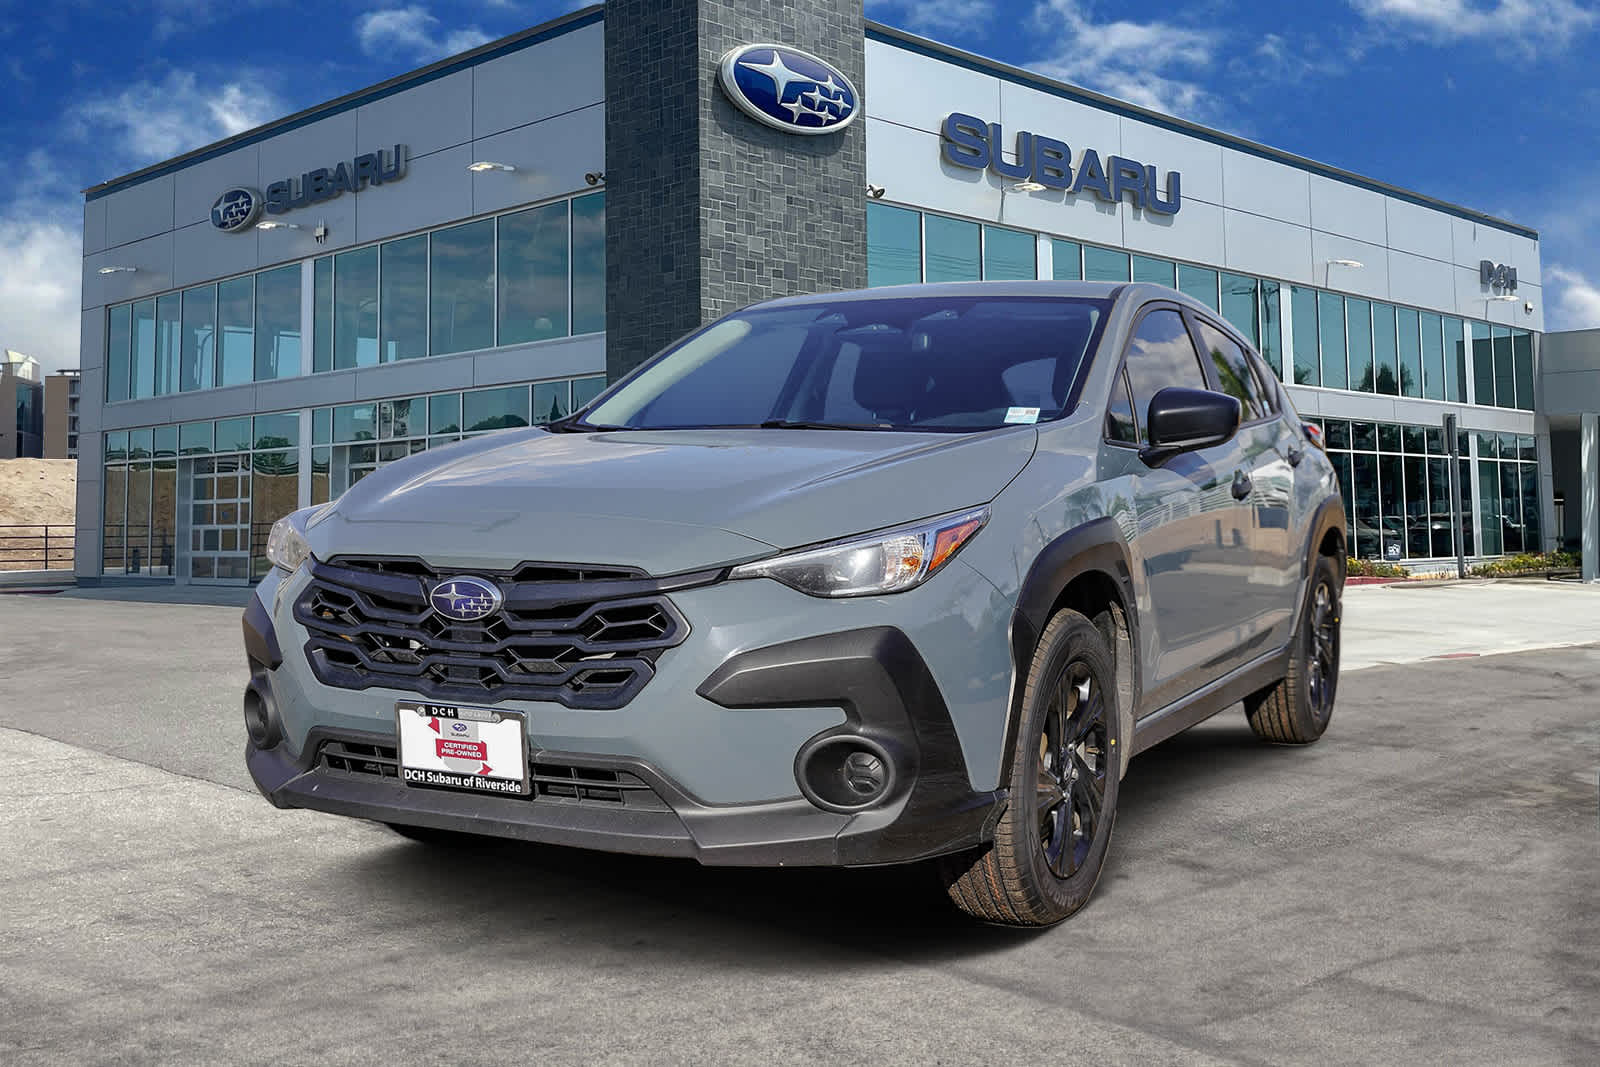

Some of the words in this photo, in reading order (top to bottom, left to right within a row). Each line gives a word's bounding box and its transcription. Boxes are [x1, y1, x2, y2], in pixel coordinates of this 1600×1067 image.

[941, 112, 1181, 215] SUBARU
[266, 144, 407, 215] SUBARU
[432, 707, 455, 717] DCH
[441, 748, 482, 758] PRE-OWNED
[443, 742, 479, 751] CERTIFIED
[404, 769, 425, 781] DCH
[427, 771, 462, 786] Subaru
[463, 776, 474, 787] of
[475, 778, 521, 793] Riverside
